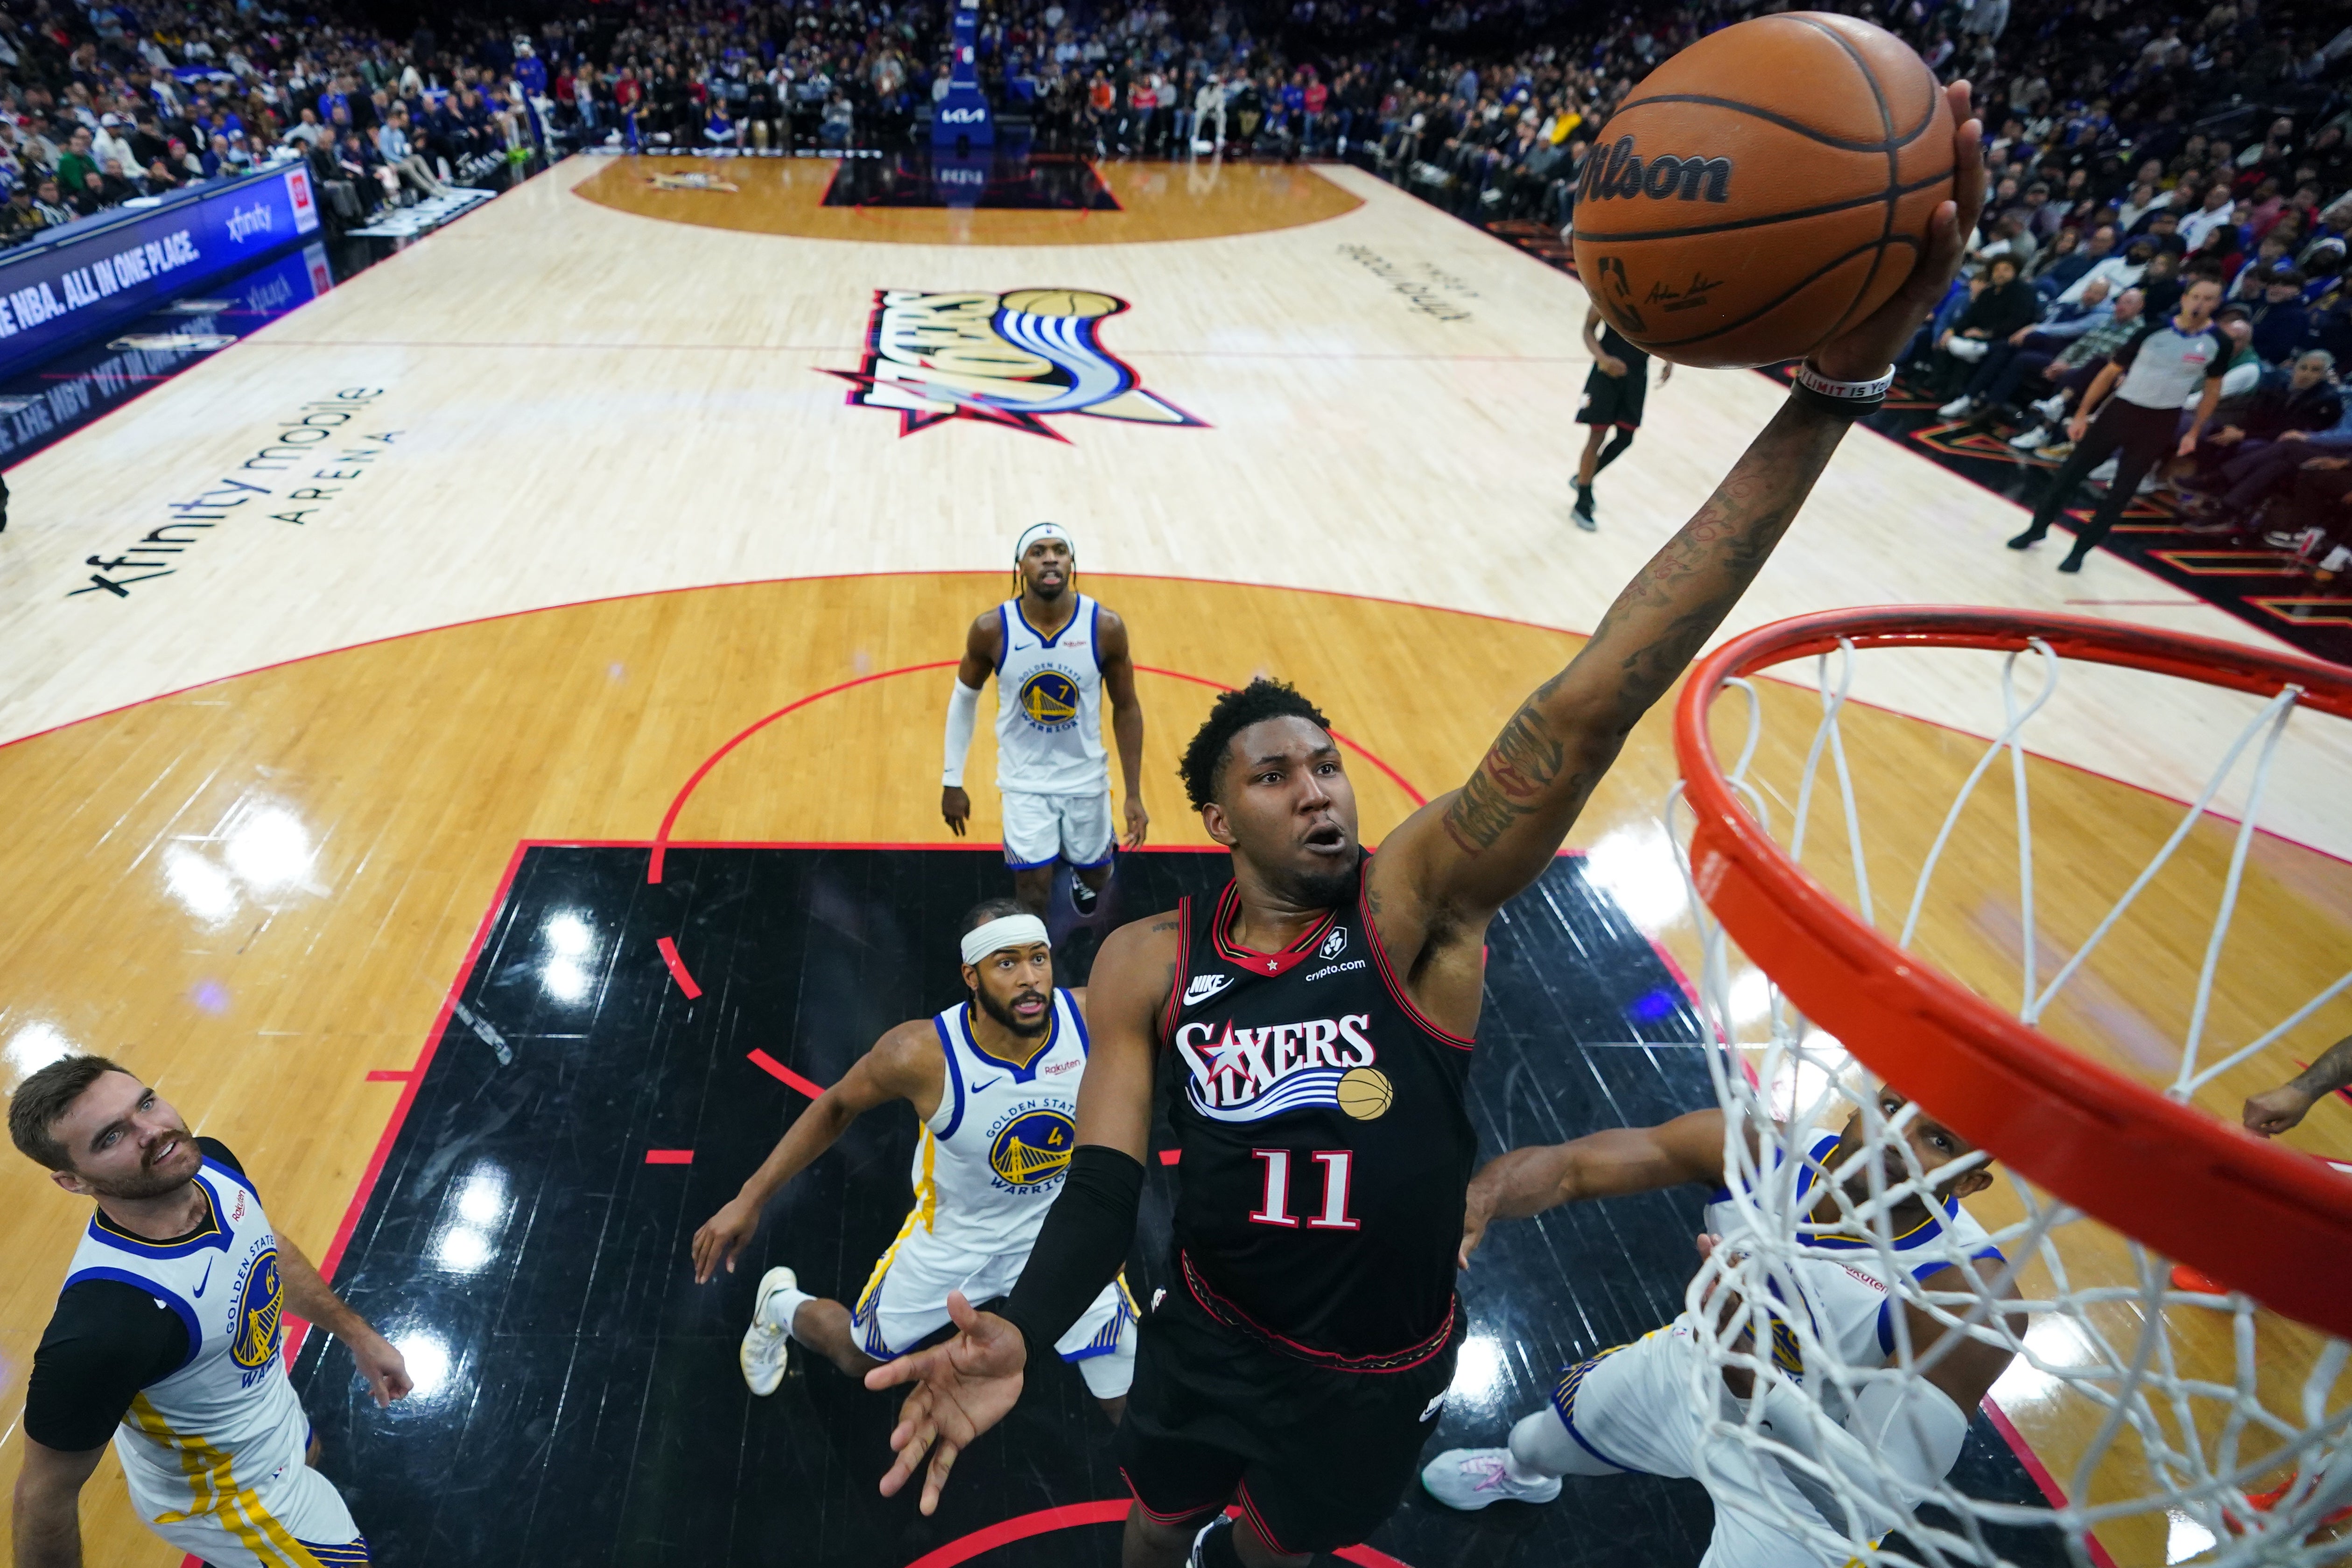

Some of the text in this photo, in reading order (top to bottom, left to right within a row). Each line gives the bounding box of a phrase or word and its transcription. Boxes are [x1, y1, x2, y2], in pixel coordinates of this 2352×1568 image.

[226, 202, 272, 243] xfinity
[9, 281, 67, 330] NBA.
[62, 267, 101, 311] ALL
[92, 256, 120, 296] IN
[113, 245, 150, 288] ONE
[144, 229, 200, 277] PLACE.
[1806, 373, 1846, 396] LIMIT
[1850, 387, 1866, 396] IS
[66, 386, 385, 598] xfinity mobile
[267, 431, 406, 526] ARENA
[1018, 662, 1053, 683] GOLDEN
[1058, 684, 1069, 700] 7
[1021, 711, 1079, 733] WARRIOR
[1190, 974, 1225, 993] NIKE
[1306, 958, 1366, 982] crypto.com
[1044, 1058, 1081, 1076] Rakuten
[986, 1099, 1036, 1138] GOLDEN
[1047, 1126, 1063, 1146] 4
[990, 1167, 1071, 1195] WARRIO
[1249, 1148, 1361, 1231] 11
[232, 1189, 246, 1222] Rakuten
[226, 1235, 274, 1334] GOLDEN STATE
